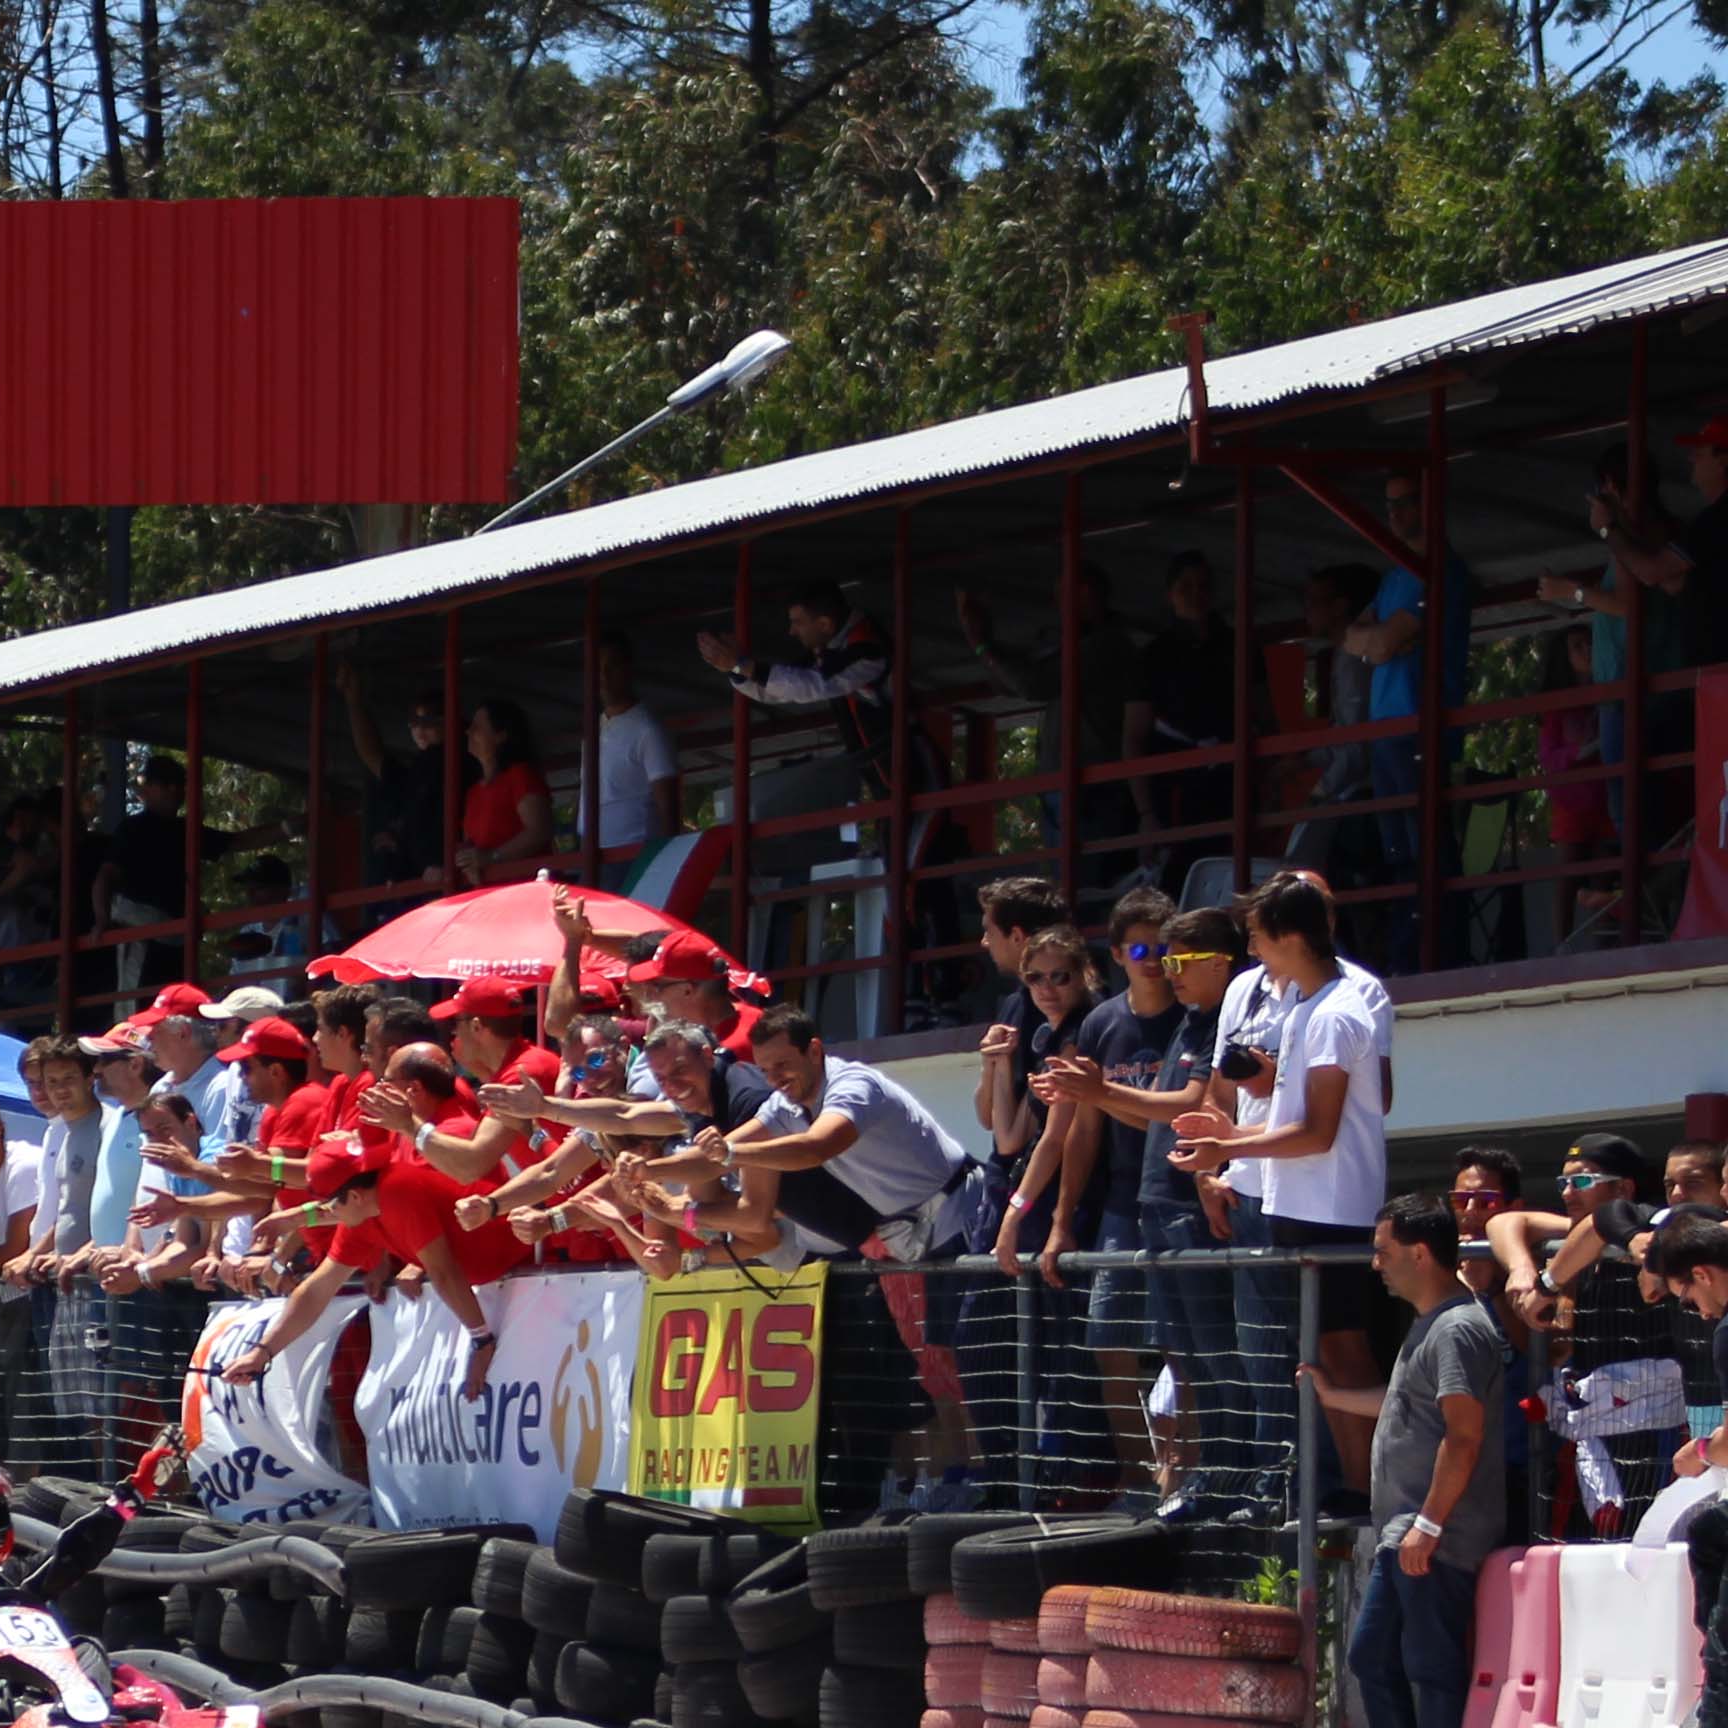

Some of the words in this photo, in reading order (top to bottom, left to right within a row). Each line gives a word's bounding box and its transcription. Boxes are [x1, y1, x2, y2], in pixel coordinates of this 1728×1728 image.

[385, 1353, 542, 1466] multicare
[650, 1303, 815, 1419] GAS
[645, 1447, 731, 1487] RACING
[738, 1443, 809, 1483] TEAM
